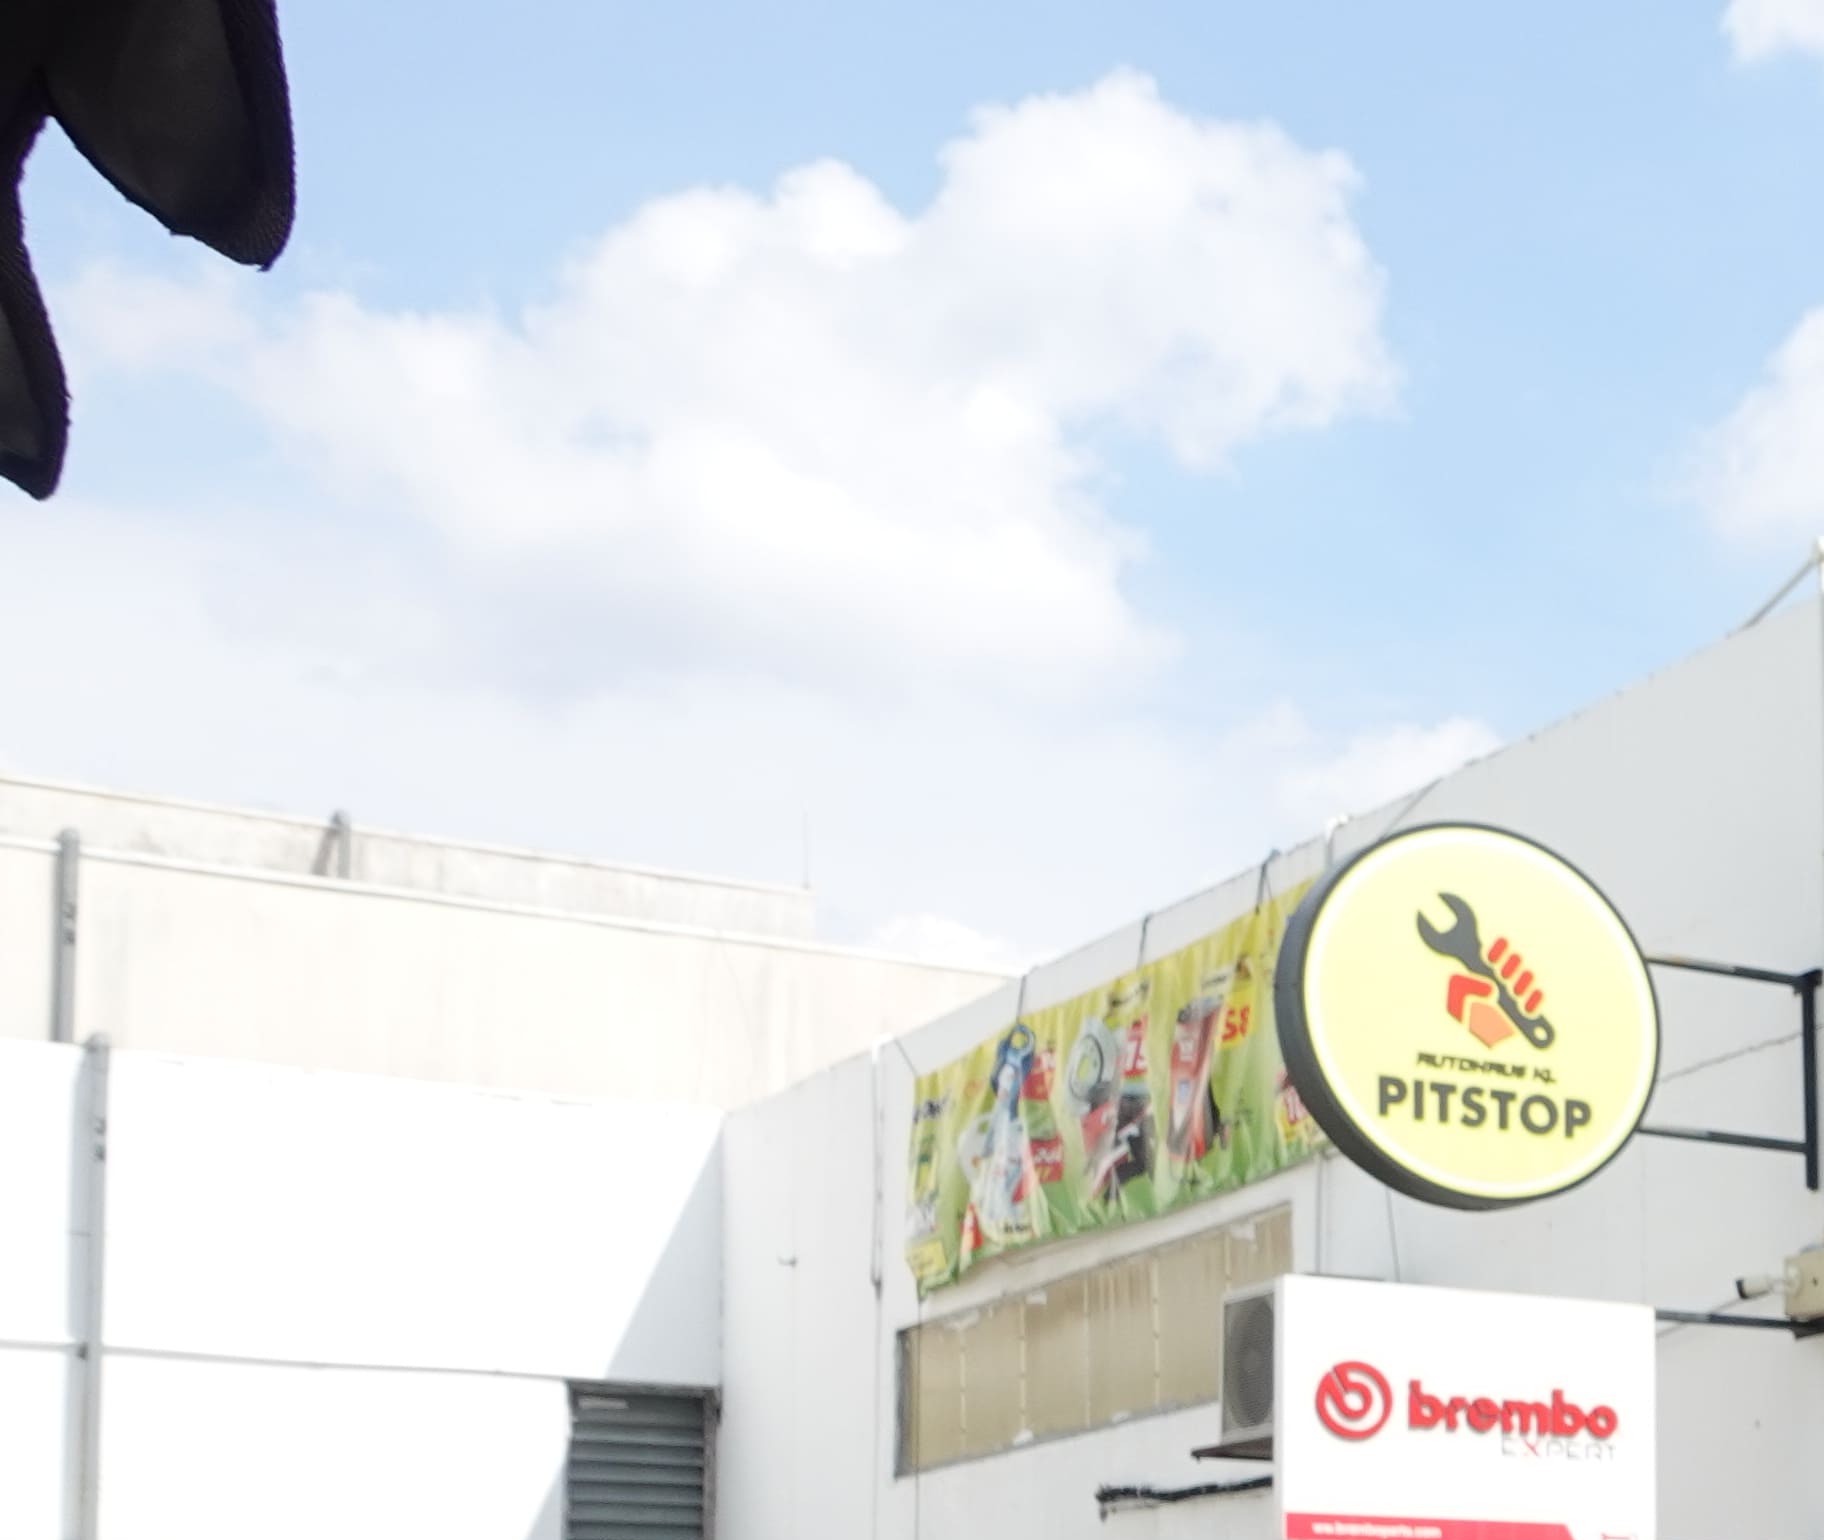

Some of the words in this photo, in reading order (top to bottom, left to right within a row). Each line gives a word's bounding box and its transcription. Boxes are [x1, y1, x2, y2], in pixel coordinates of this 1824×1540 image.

[1416, 1052, 1525, 1078] AUTOHAUS
[1533, 1068, 1556, 1084] KL
[1378, 1076, 1592, 1139] PITSTOP
[1407, 1379, 1619, 1440] brembo
[1501, 1435, 1617, 1462] EXPERT
